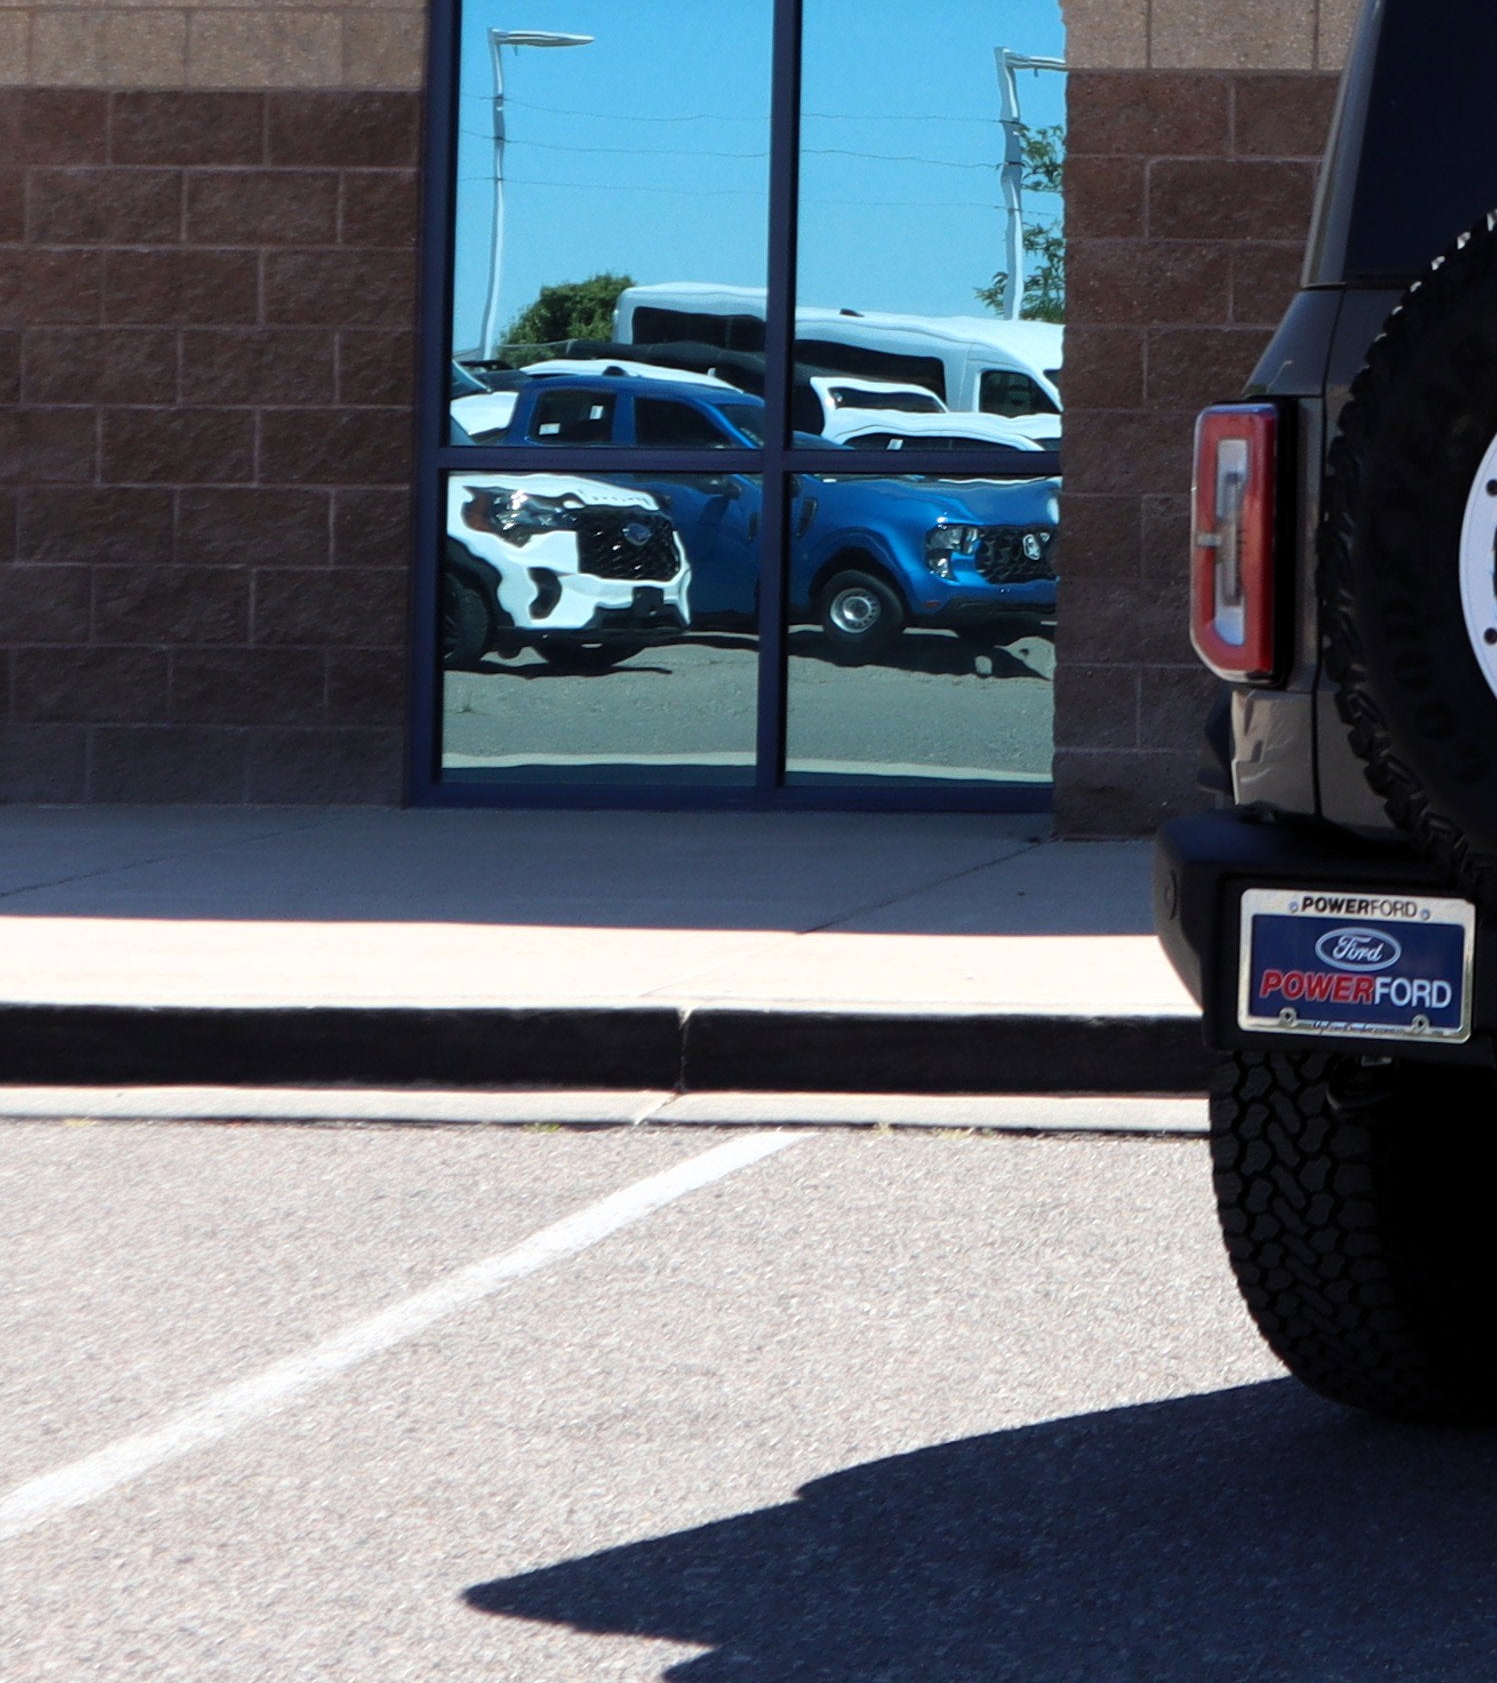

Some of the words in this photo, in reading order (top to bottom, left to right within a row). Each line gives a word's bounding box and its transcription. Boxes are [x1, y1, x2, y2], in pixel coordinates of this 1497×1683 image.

[1301, 895, 1418, 918] POWERFORD
[1332, 934, 1385, 963] Ford
[1259, 969, 1451, 1009] POWERFORD
